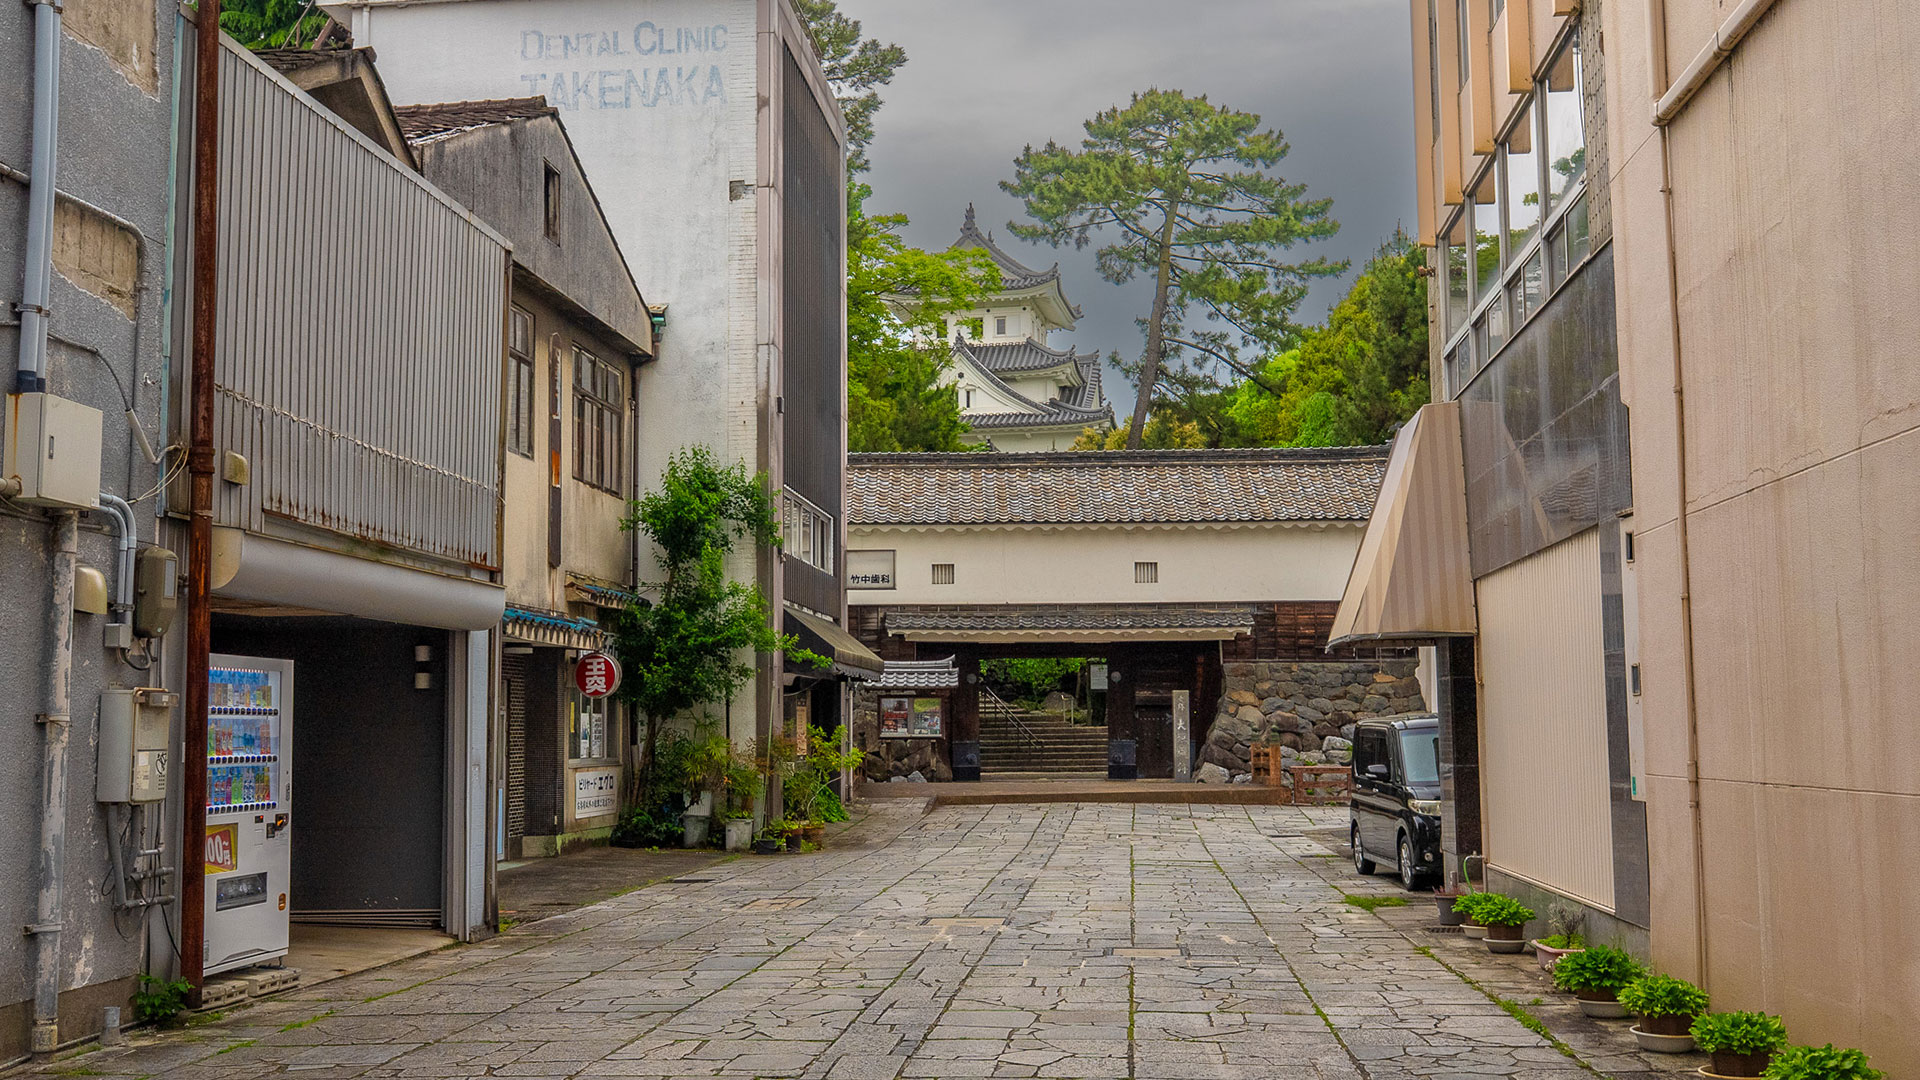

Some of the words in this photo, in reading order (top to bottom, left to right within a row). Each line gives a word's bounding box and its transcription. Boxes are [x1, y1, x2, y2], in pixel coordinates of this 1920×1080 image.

[520, 30, 630, 60] DENTAL
[633, 21, 728, 55] CLINIC
[520, 65, 728, 111] TAKENAKA
[851, 574, 890, 584] 竹中歯科
